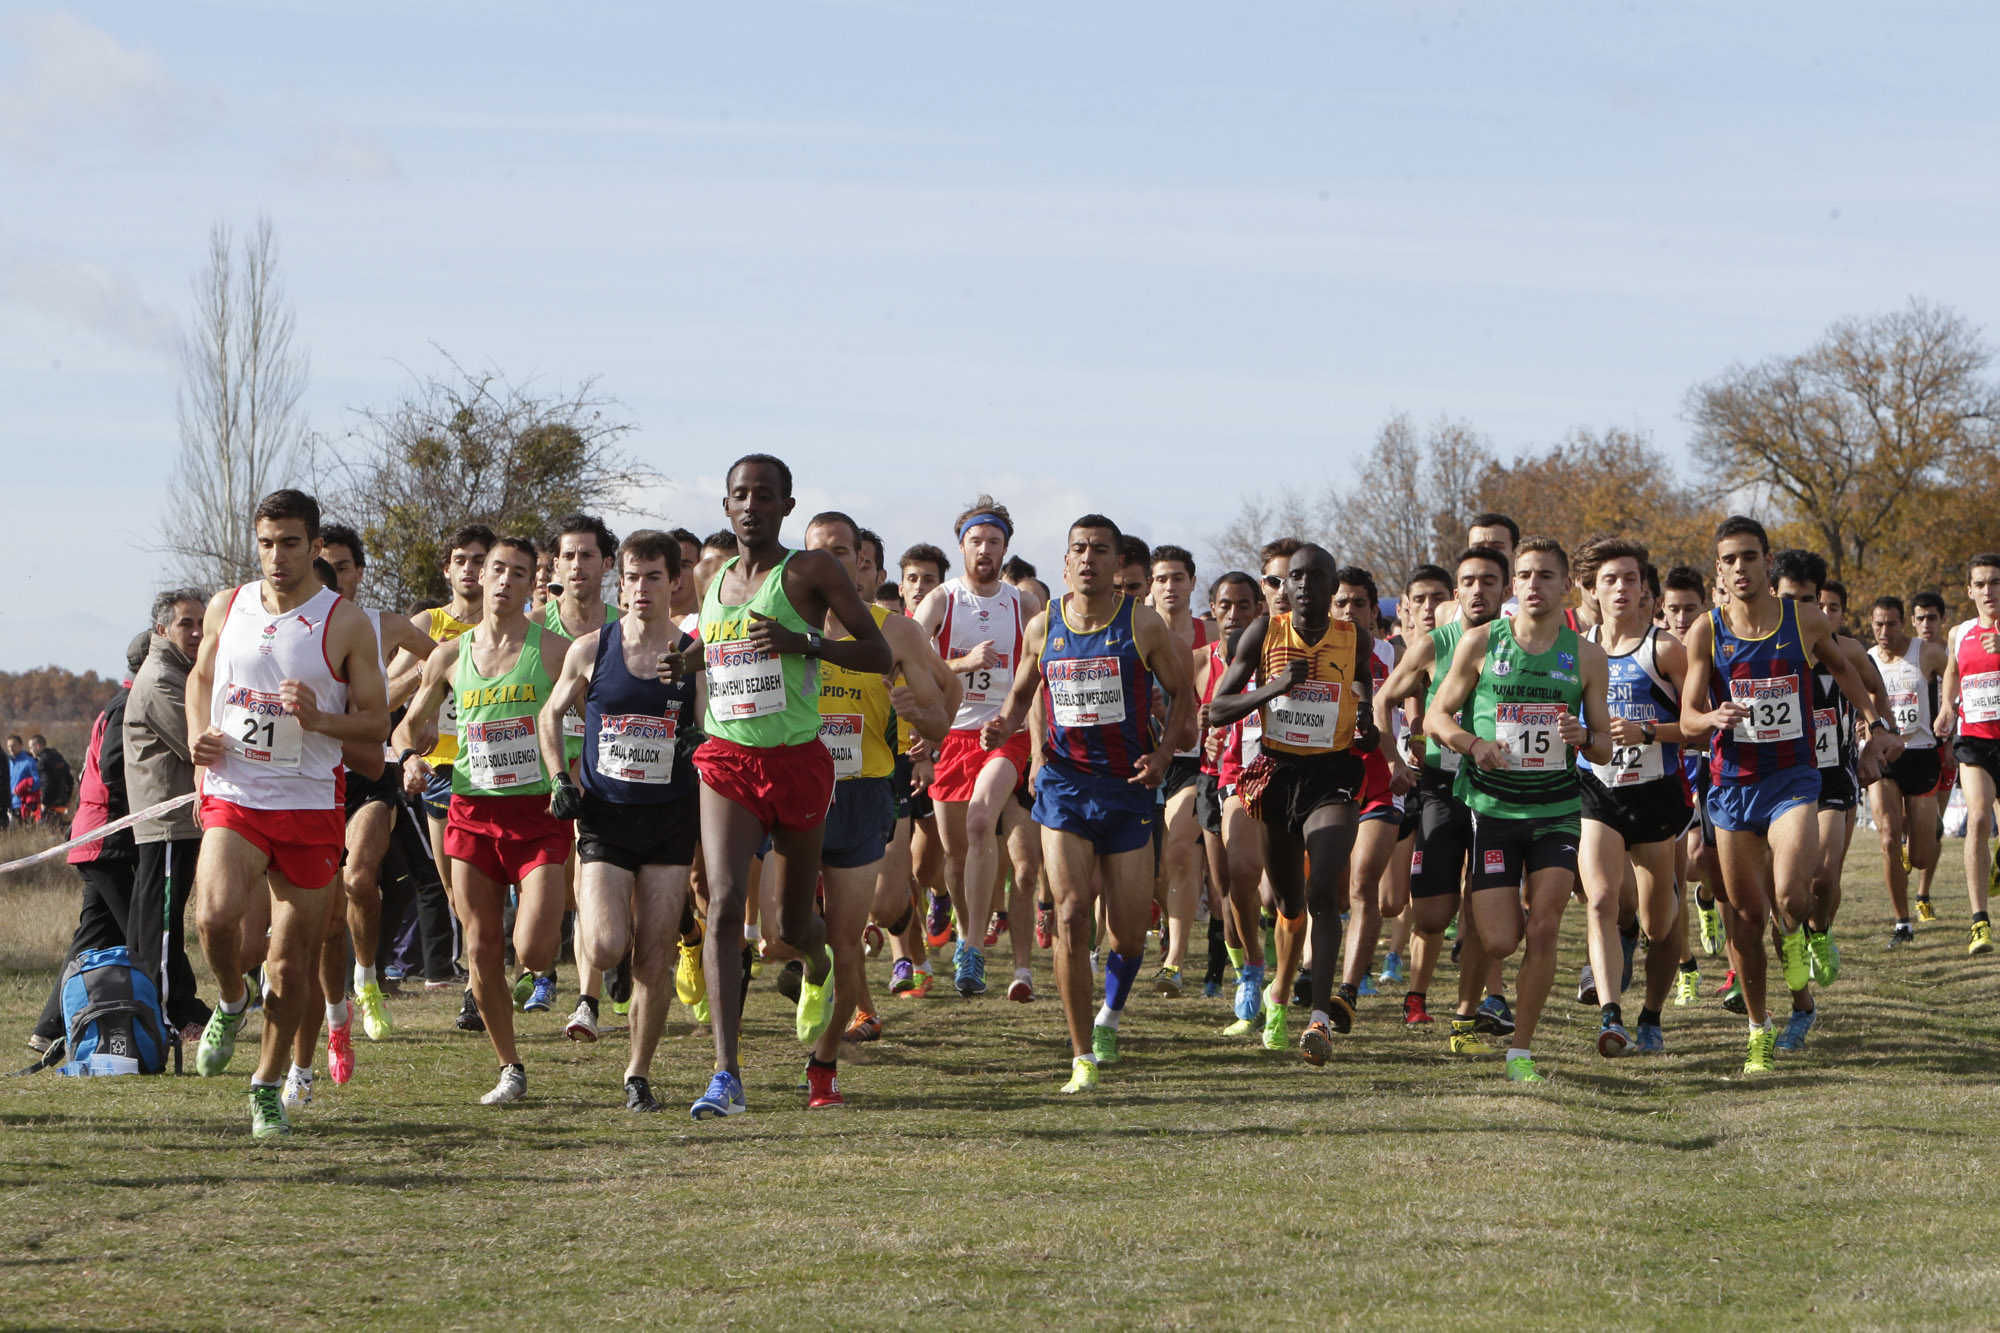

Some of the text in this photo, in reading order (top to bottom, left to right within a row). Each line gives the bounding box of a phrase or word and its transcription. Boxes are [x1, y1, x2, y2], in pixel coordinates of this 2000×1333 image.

[965, 671, 991, 690] 13
[1070, 668, 1111, 682] SORIA
[746, 674, 782, 694] BEZABEH
[1051, 680, 1067, 693] 12
[1493, 684, 1563, 700] PLAYAS DE CASTELLÓN
[463, 684, 537, 710] BIKILA
[1054, 689, 1121, 706] ABDELAZIZ MERZOGUI
[1290, 689, 1332, 703] SORIA
[1754, 685, 1793, 700] SORIA
[1972, 696, 1987, 708] DANIEL
[1294, 711, 1324, 727] DICKSON
[1624, 704, 1656, 720] ATLETICO
[1747, 702, 1792, 727] 132
[1897, 708, 1917, 724] 46
[242, 719, 274, 747] 21
[486, 726, 528, 744] SORIA
[625, 725, 667, 739] SORIA
[819, 724, 854, 737] ORIA
[469, 743, 479, 753] 16
[1519, 731, 1550, 754] 15
[471, 748, 536, 769] DAVID SOLIS LUENGO
[610, 745, 660, 763] PAUL POLLOCK
[829, 747, 852, 761] BADIA
[1611, 746, 1642, 770] 42
